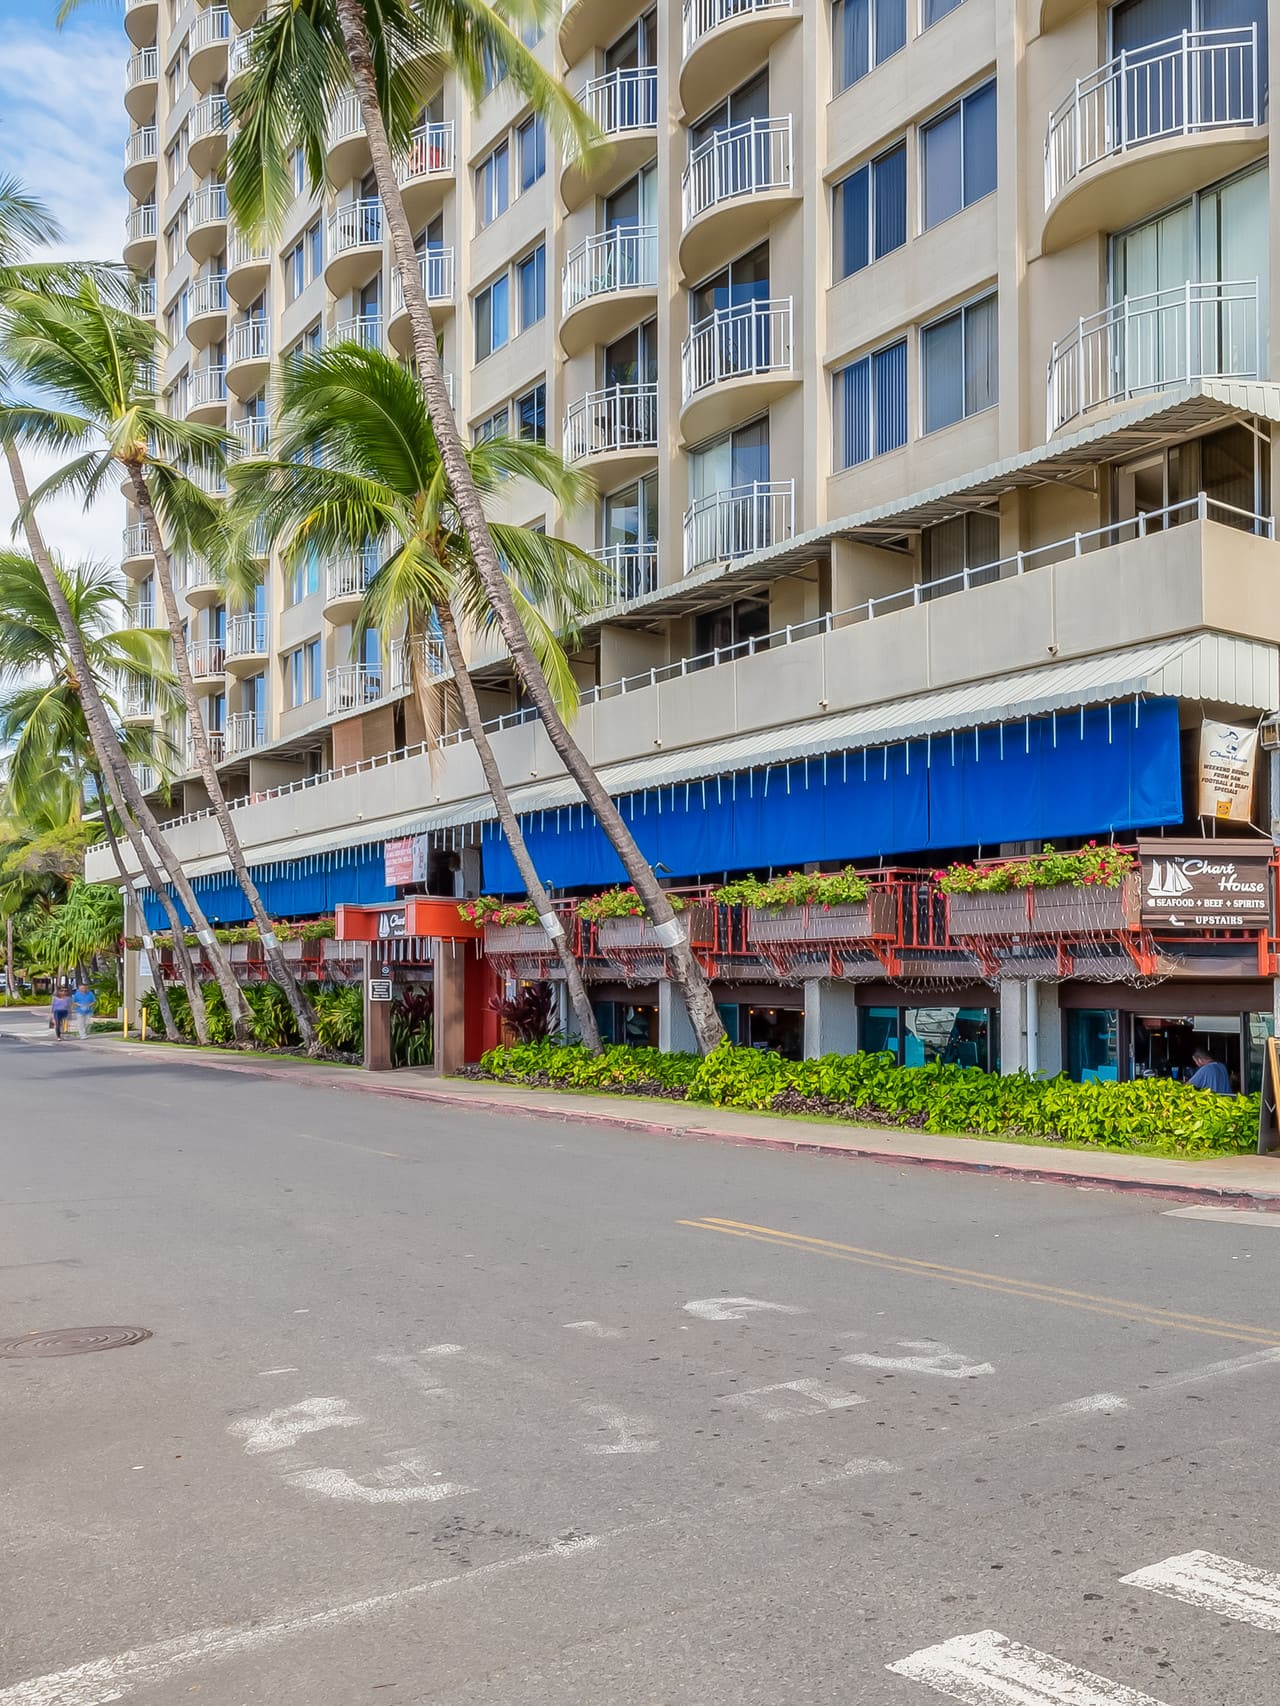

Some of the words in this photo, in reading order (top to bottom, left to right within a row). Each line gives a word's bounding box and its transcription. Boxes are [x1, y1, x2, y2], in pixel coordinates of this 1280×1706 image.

[1204, 763, 1231, 774] WEEKEND
[1214, 772, 1230, 780] FROM
[1202, 777, 1228, 787] FOOTBALL
[1214, 785, 1239, 795] SPECIALS
[1183, 859, 1235, 876] Chart
[1218, 873, 1265, 892] House
[1157, 898, 1195, 907] SEAFOOD
[1204, 898, 1224, 908] BEEF
[1233, 899, 1266, 909] SPIRITS
[1196, 915, 1244, 925] UPSTAIRS
